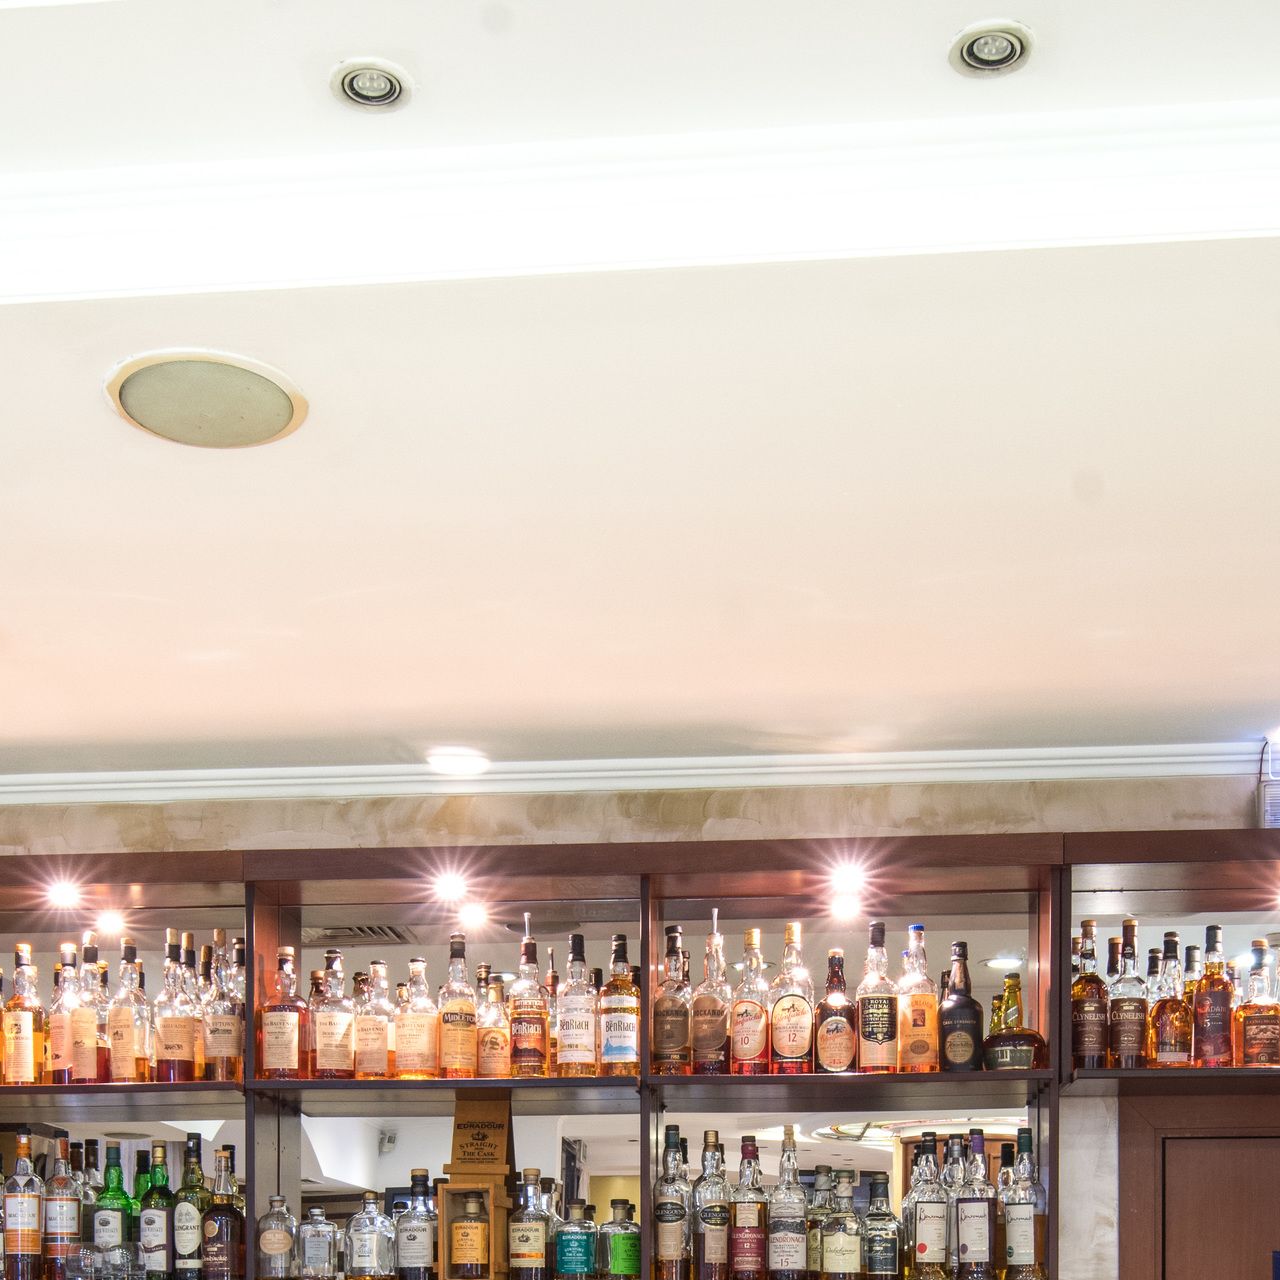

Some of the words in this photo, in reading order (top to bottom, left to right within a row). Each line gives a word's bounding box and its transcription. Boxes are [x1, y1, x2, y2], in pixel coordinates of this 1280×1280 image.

[1072, 1012, 1106, 1021] CLYNELISH
[1111, 1011, 1145, 1020] CLYNELISH
[740, 1036, 750, 1046] 10
[788, 1033, 798, 1043] 12
[459, 1142, 499, 1151] STRAIGHT
[780, 1257, 790, 1268] 15
